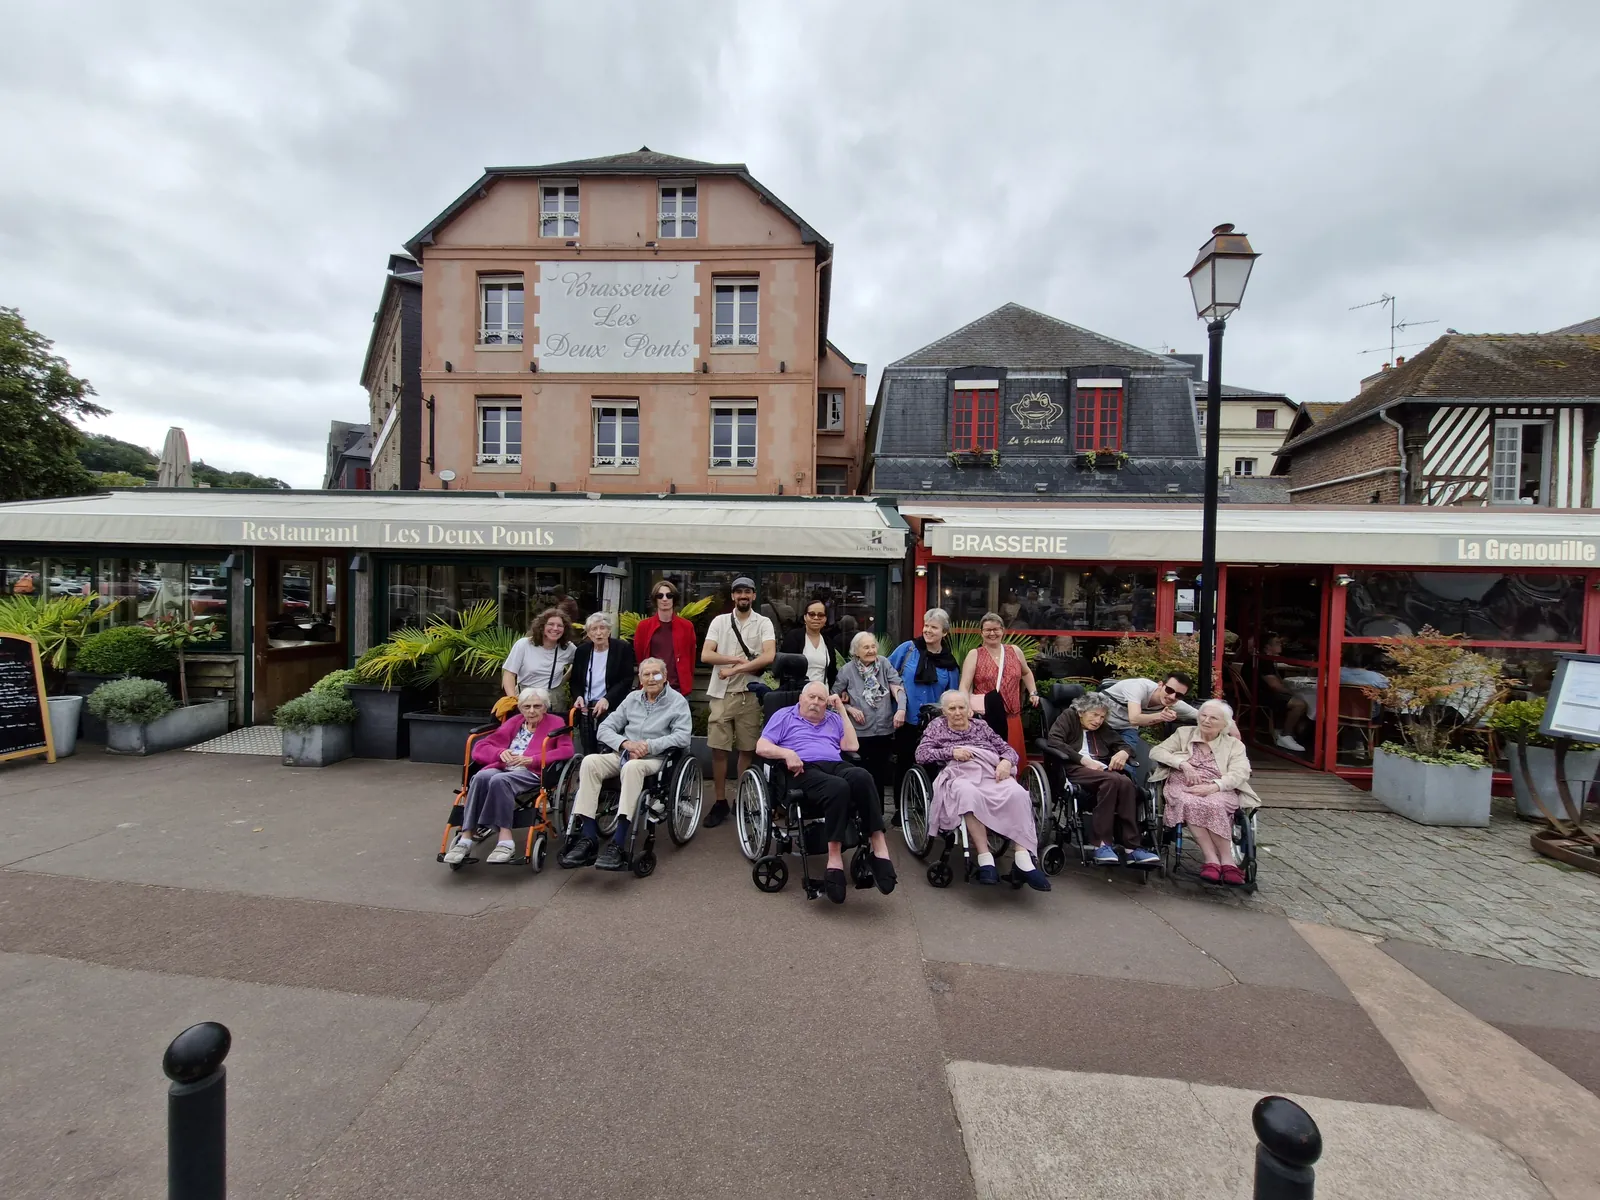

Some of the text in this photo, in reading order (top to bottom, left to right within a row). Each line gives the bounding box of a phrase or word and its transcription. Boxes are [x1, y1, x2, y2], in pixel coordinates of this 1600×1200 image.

[561, 271, 672, 297] Brasserie
[593, 303, 640, 327] Les
[543, 332, 692, 359] Deux Ponts
[1007, 436, 1064, 446] La Grenouille
[241, 521, 554, 546] Restaurant Les Deux Ponts
[952, 534, 1068, 554] BRASSERIE
[1458, 539, 1596, 561] La Grenouille
